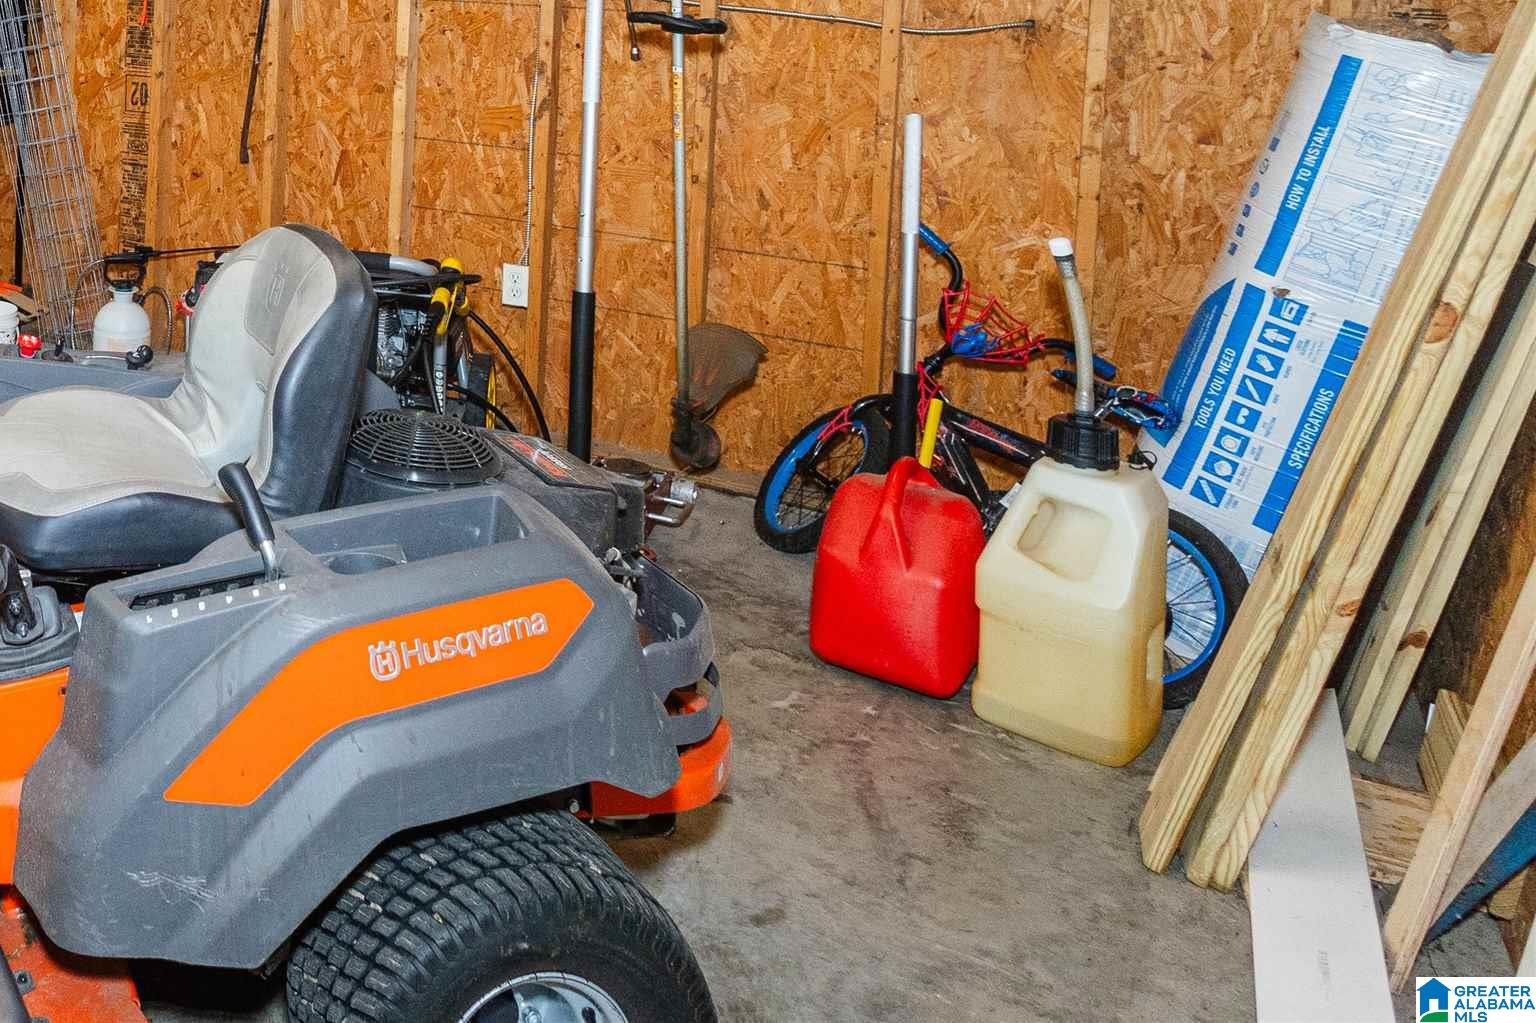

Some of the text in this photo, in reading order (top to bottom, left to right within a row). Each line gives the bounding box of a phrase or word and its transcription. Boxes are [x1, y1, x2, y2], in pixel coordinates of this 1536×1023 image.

[1285, 126, 1330, 210] HOW TO INSTALL
[1193, 348, 1236, 428] TOOLS YOU NEED
[1288, 388, 1335, 469] SPECIFICATIONS
[400, 612, 549, 669] Husqvarna
